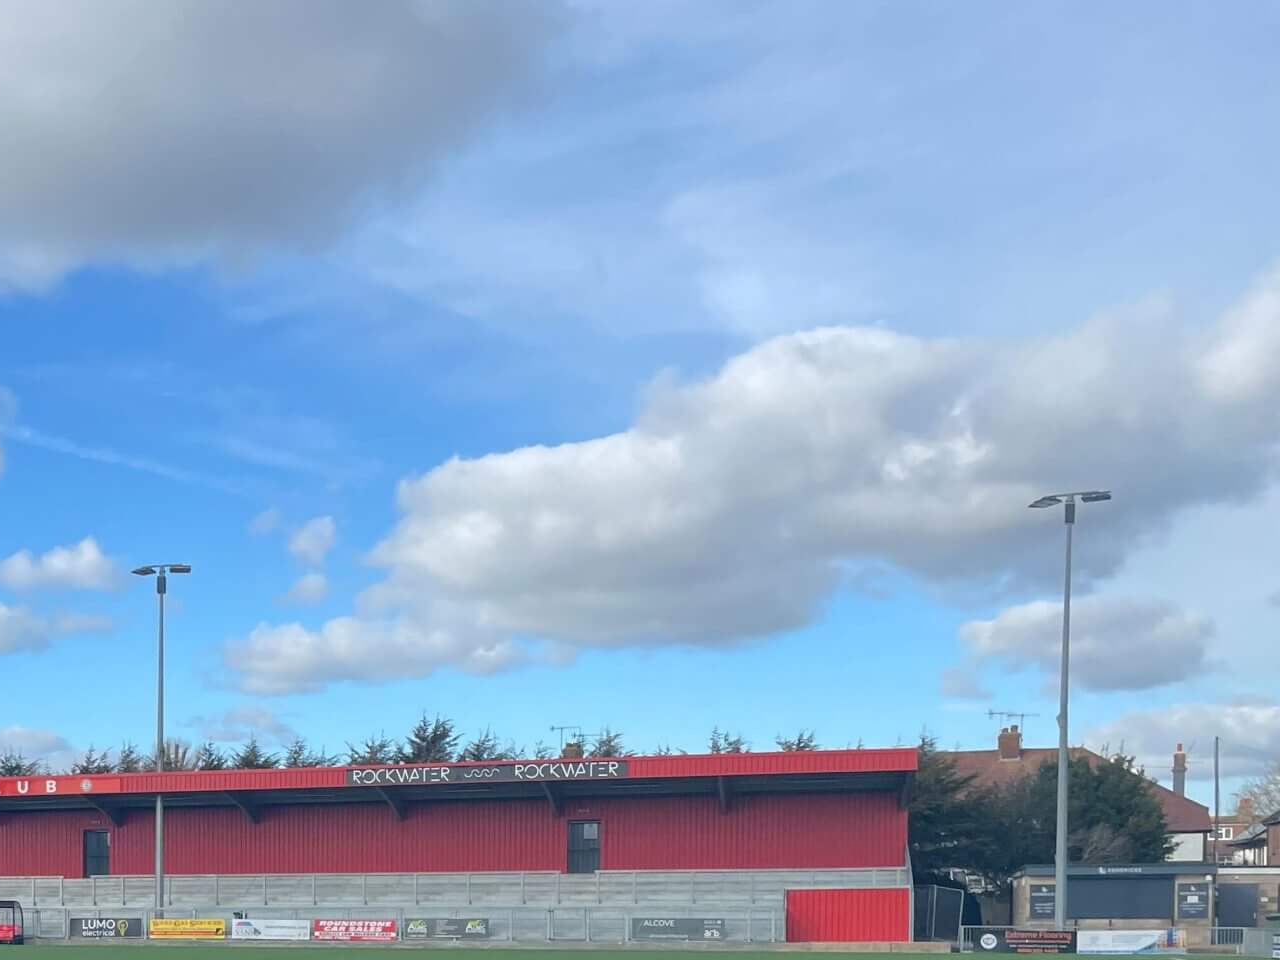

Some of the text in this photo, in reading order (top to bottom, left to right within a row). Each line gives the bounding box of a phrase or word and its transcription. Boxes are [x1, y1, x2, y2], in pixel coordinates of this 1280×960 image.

[352, 767, 450, 784] ROCKWATER
[515, 761, 619, 777] ROCKWATER
[82, 919, 116, 930] LUMO
[643, 919, 675, 928] ALCOVE
